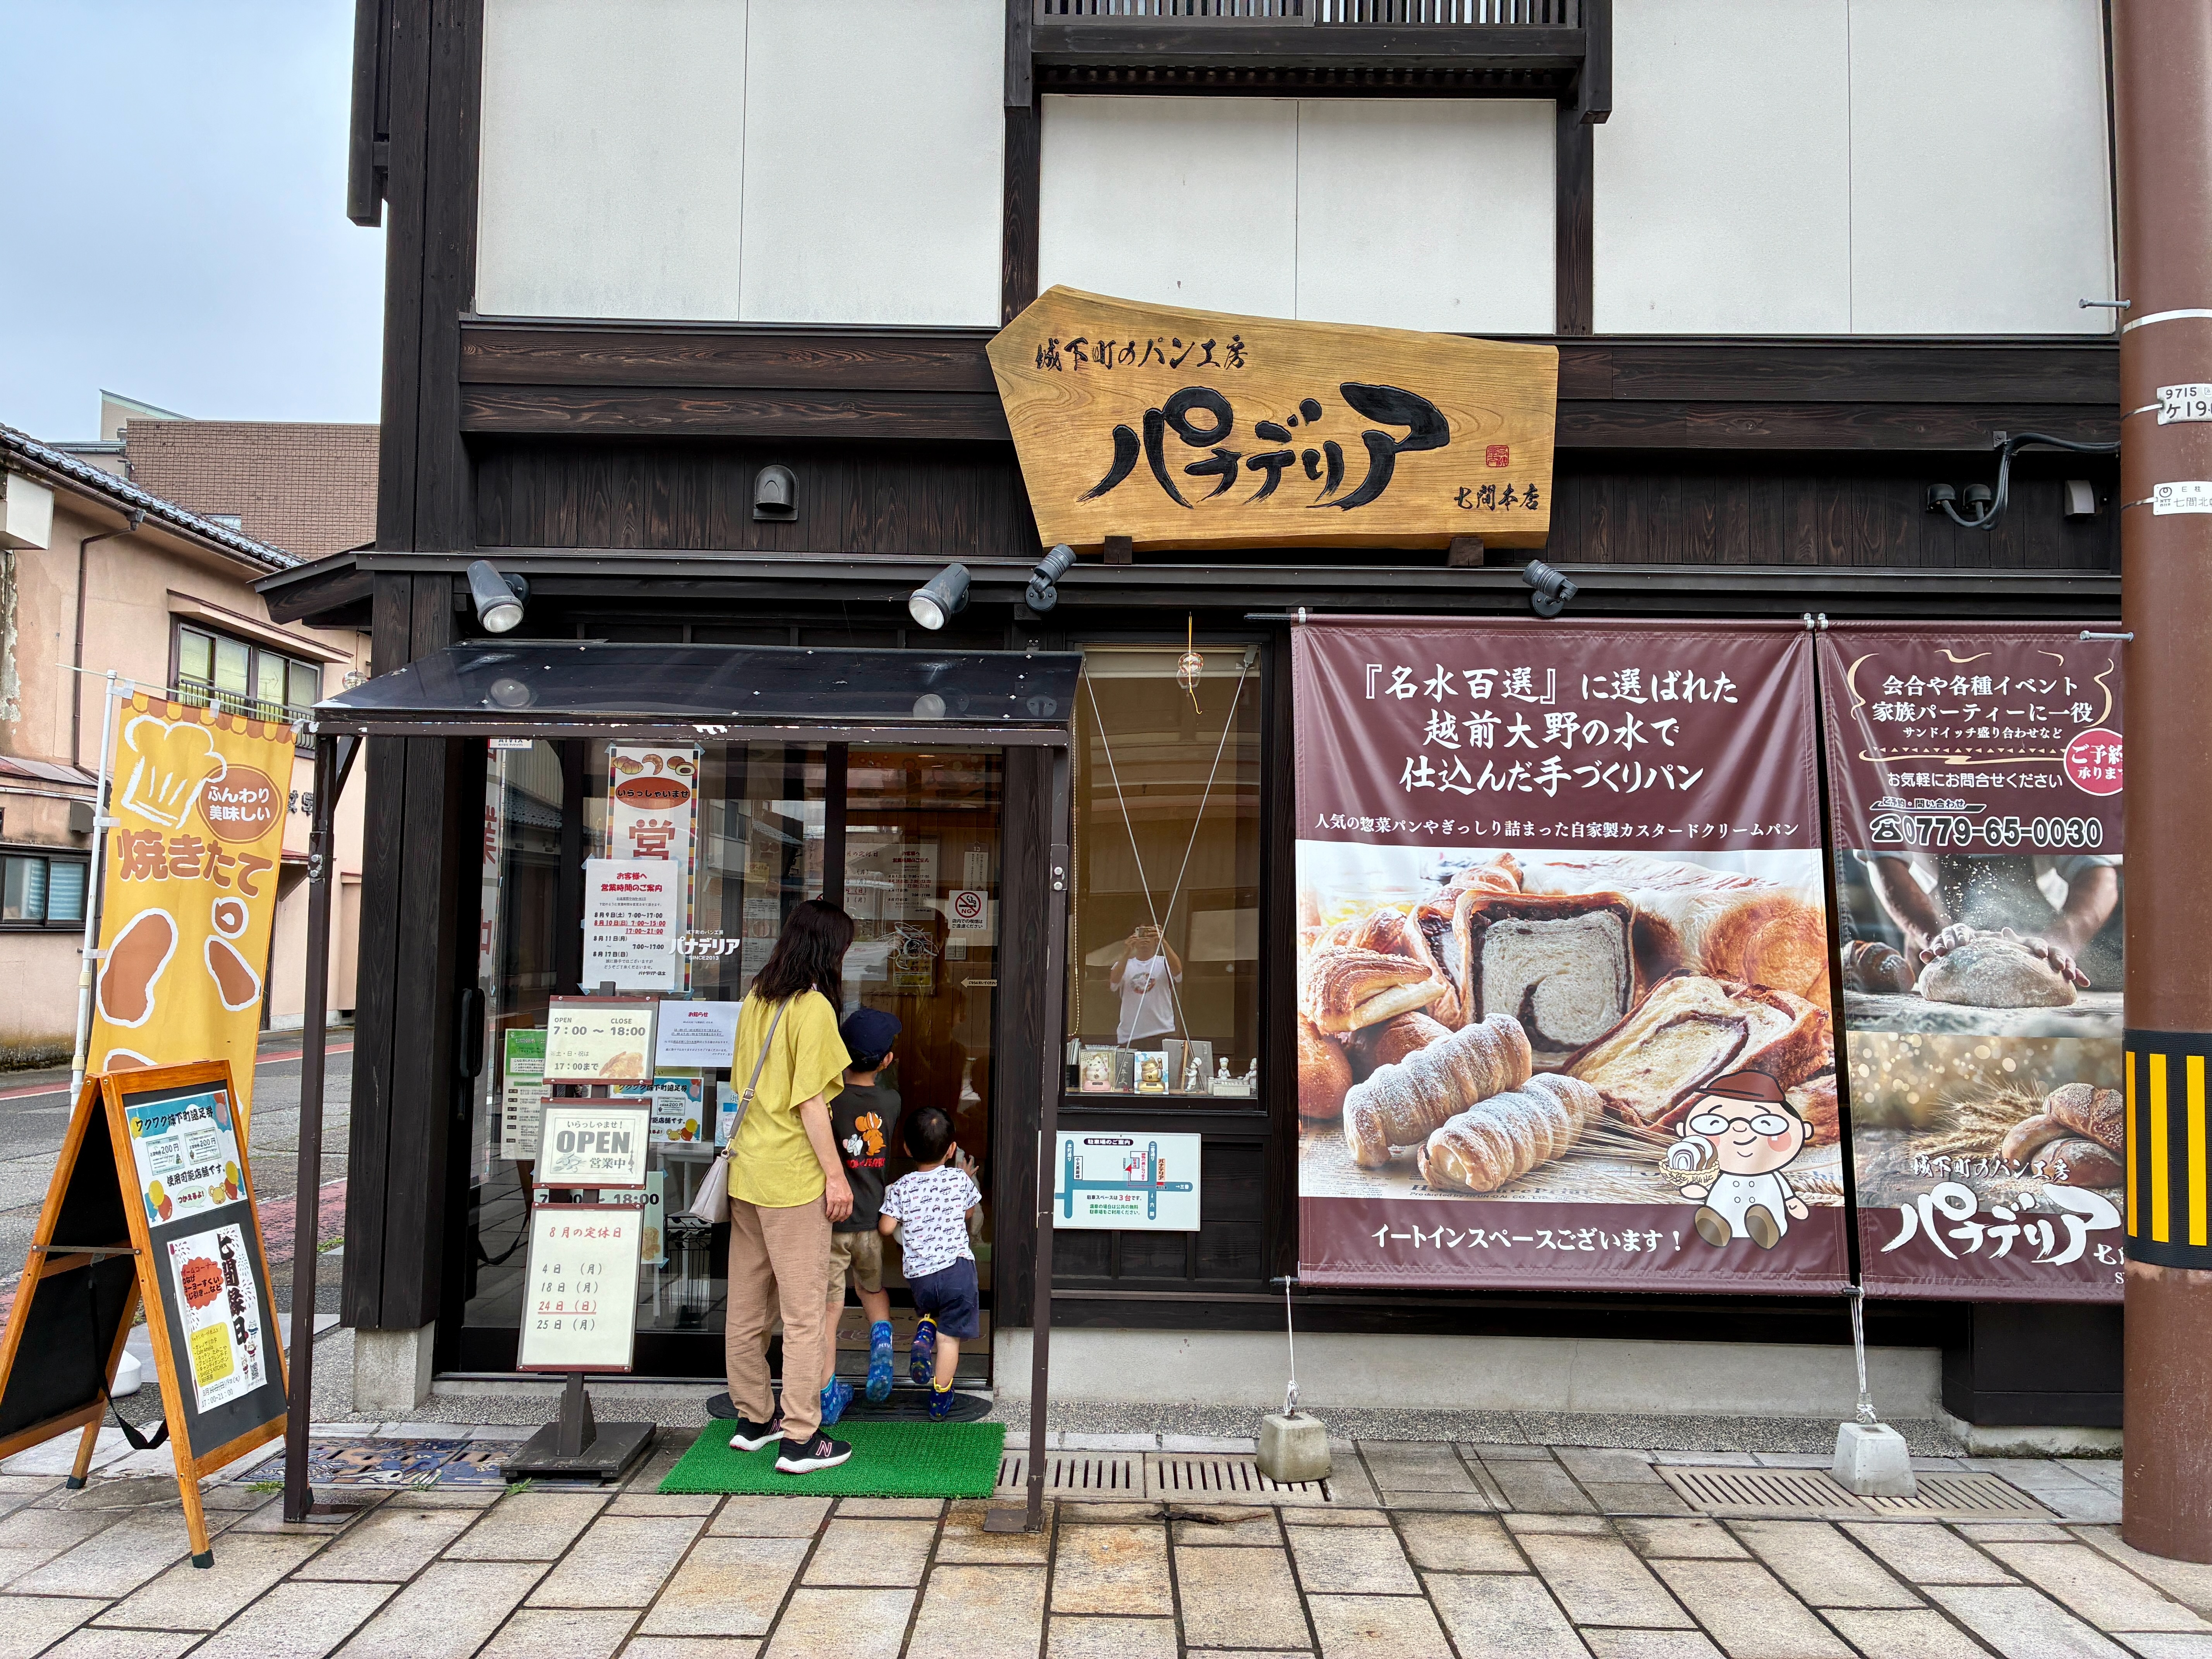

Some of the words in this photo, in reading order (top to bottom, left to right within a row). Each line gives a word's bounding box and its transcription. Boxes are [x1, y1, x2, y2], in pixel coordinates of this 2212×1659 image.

[1036, 334, 1248, 372] 城下町のパン工房
[2166, 387, 2197, 400] 9715
[1077, 381, 1450, 511] パナデリア
[1454, 483, 1540, 511] 七間本店
[1882, 675, 2077, 697] 会合や各種イベント
[1872, 701, 2094, 723] 家族パーティーに一役
[1423, 711, 1680, 751] 越前大野の水で
[1903, 726, 2063, 739] サンドイッチ盛り合わせなど
[1400, 755, 1704, 797] 仕込んだ手づくりパン
[1887, 772, 2063, 788] お気軽にお問合せください
[208, 786, 270, 805] ふんわり
[617, 788, 689, 798] いらっしゃいませ
[1883, 796, 1965, 809] ご予約・問い合わせ
[209, 804, 271, 823] 美味しい
[1315, 814, 1799, 840] 人気の惣菜パンやぎっしり詰まった自家製カスタードクリームパン
[1902, 815, 2103, 848] 0779-65-0030
[629, 819, 675, 860] 営
[117, 828, 274, 898] 焼きたて
[669, 936, 740, 955] パナデリア
[611, 1027, 646, 1036] 18:00
[161, 1143, 180, 1154] 200円
[200, 1137, 216, 1147] 200円
[556, 1130, 630, 1154] OPEN
[590, 1158, 626, 1169] 営業中
[1913, 1154, 2071, 1181] 城下町のパン工房
[178, 1190, 204, 1204] つかえるよ!
[550, 1227, 622, 1238] 8月の定休日
[1881, 1181, 2122, 1266] パナデリア
[1371, 1223, 1682, 1253] イートインスペースございます!
[2094, 1243, 2124, 1265] 七
[543, 1264, 561, 1274] 4日
[580, 1263, 603, 1275] (月)
[541, 1282, 565, 1293] 18日
[577, 1282, 598, 1293] (月)
[538, 1301, 563, 1311] 24日
[575, 1300, 596, 1312] (日)
[537, 1319, 562, 1330] 25日
[573, 1319, 595, 1331] (月)
[816, 1441, 832, 1457] N
